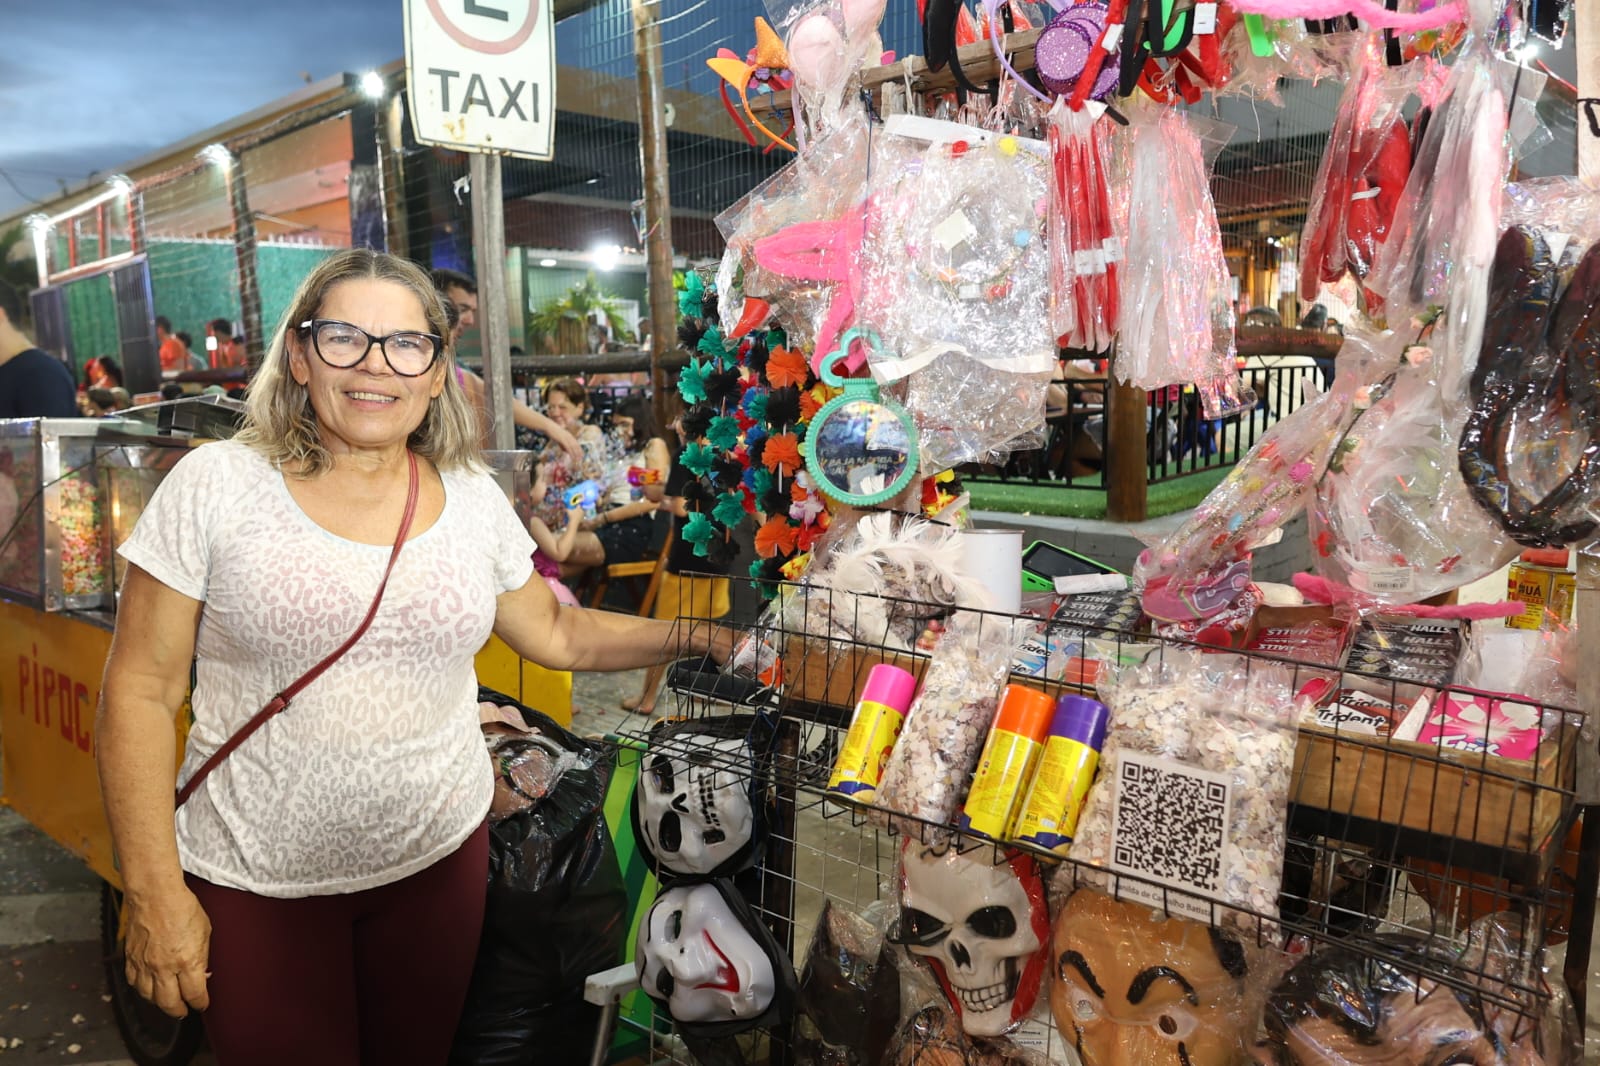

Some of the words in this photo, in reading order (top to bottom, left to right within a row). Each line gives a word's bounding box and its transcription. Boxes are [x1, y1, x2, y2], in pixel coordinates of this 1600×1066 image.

[428, 68, 540, 123] TAXI
[1070, 602, 1108, 611] HALLS
[1063, 611, 1102, 619] HALLS
[1410, 624, 1452, 634] HALLS
[1403, 636, 1453, 647] HALLS
[1404, 647, 1447, 656] HALLS
[1318, 709, 1385, 727] Trident
